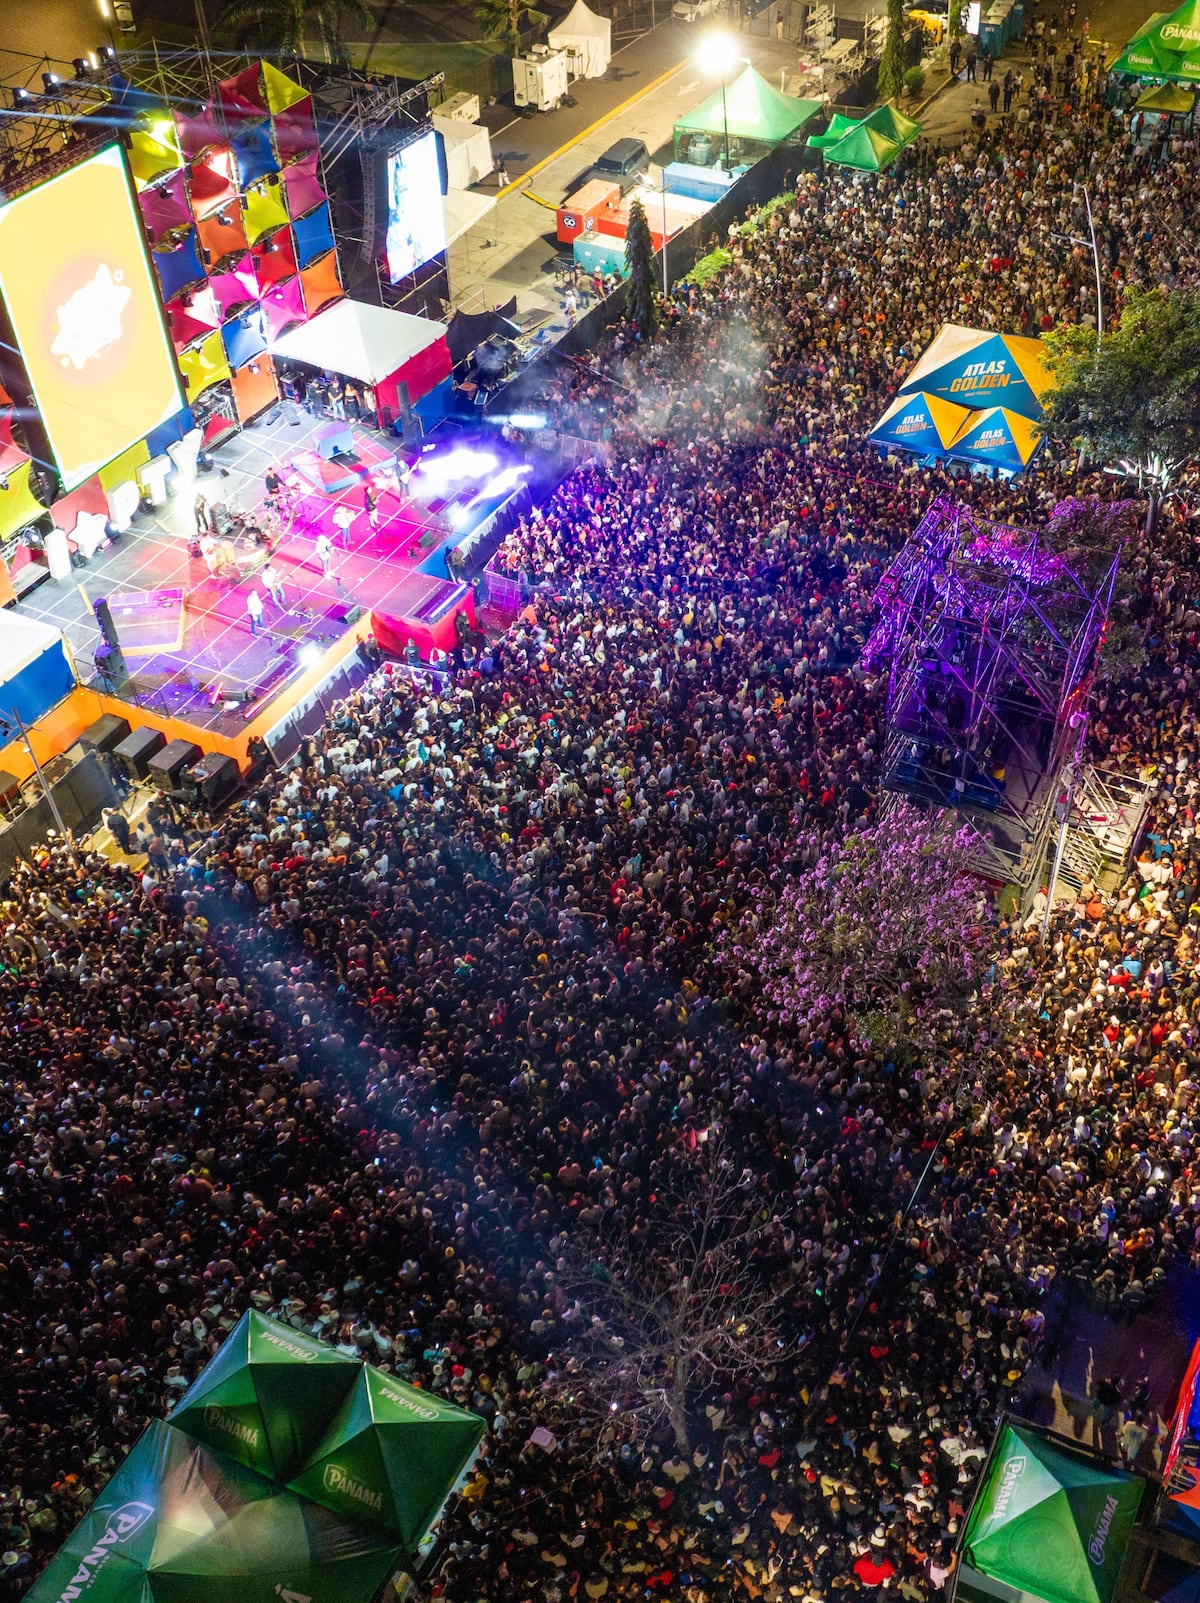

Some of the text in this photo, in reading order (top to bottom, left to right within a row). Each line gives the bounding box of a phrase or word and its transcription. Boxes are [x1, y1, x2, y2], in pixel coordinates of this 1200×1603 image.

[962, 361, 1006, 377] ATLAS
[950, 374, 1010, 392] GOLDEN
[902, 414, 924, 424] ATLAS
[896, 423, 926, 434] GOLDEN
[981, 429, 1003, 439] ATLAS
[974, 437, 1005, 448] GOLDEN
[329, 1469, 384, 1511] PANAMÁ
[992, 1461, 1022, 1518] PANAMÁ
